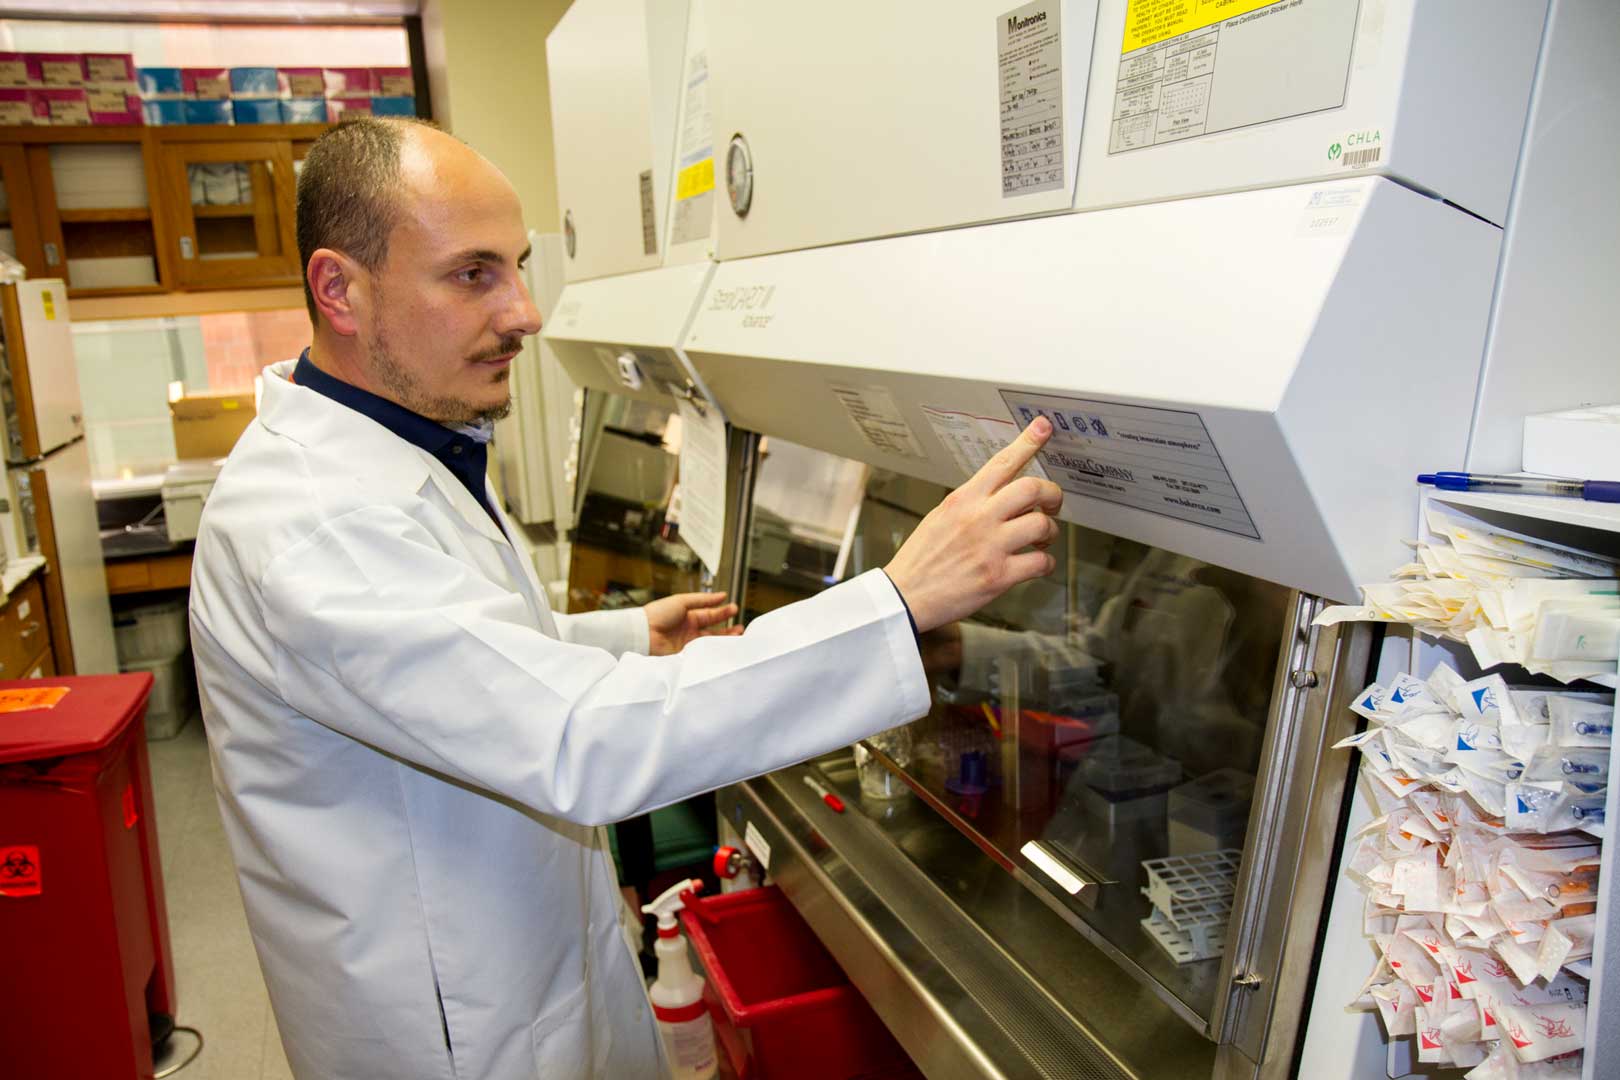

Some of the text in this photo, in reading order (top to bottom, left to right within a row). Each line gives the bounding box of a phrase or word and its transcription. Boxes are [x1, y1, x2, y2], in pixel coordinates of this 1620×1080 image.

[1225, 20, 1240, 29] Place
[1240, 9, 1271, 25] Certification
[1270, 4, 1290, 14] Sticker
[1347, 129, 1381, 147] CHLA
[1058, 453, 1087, 471] BAKER
[1086, 459, 1135, 482] COMPANY
